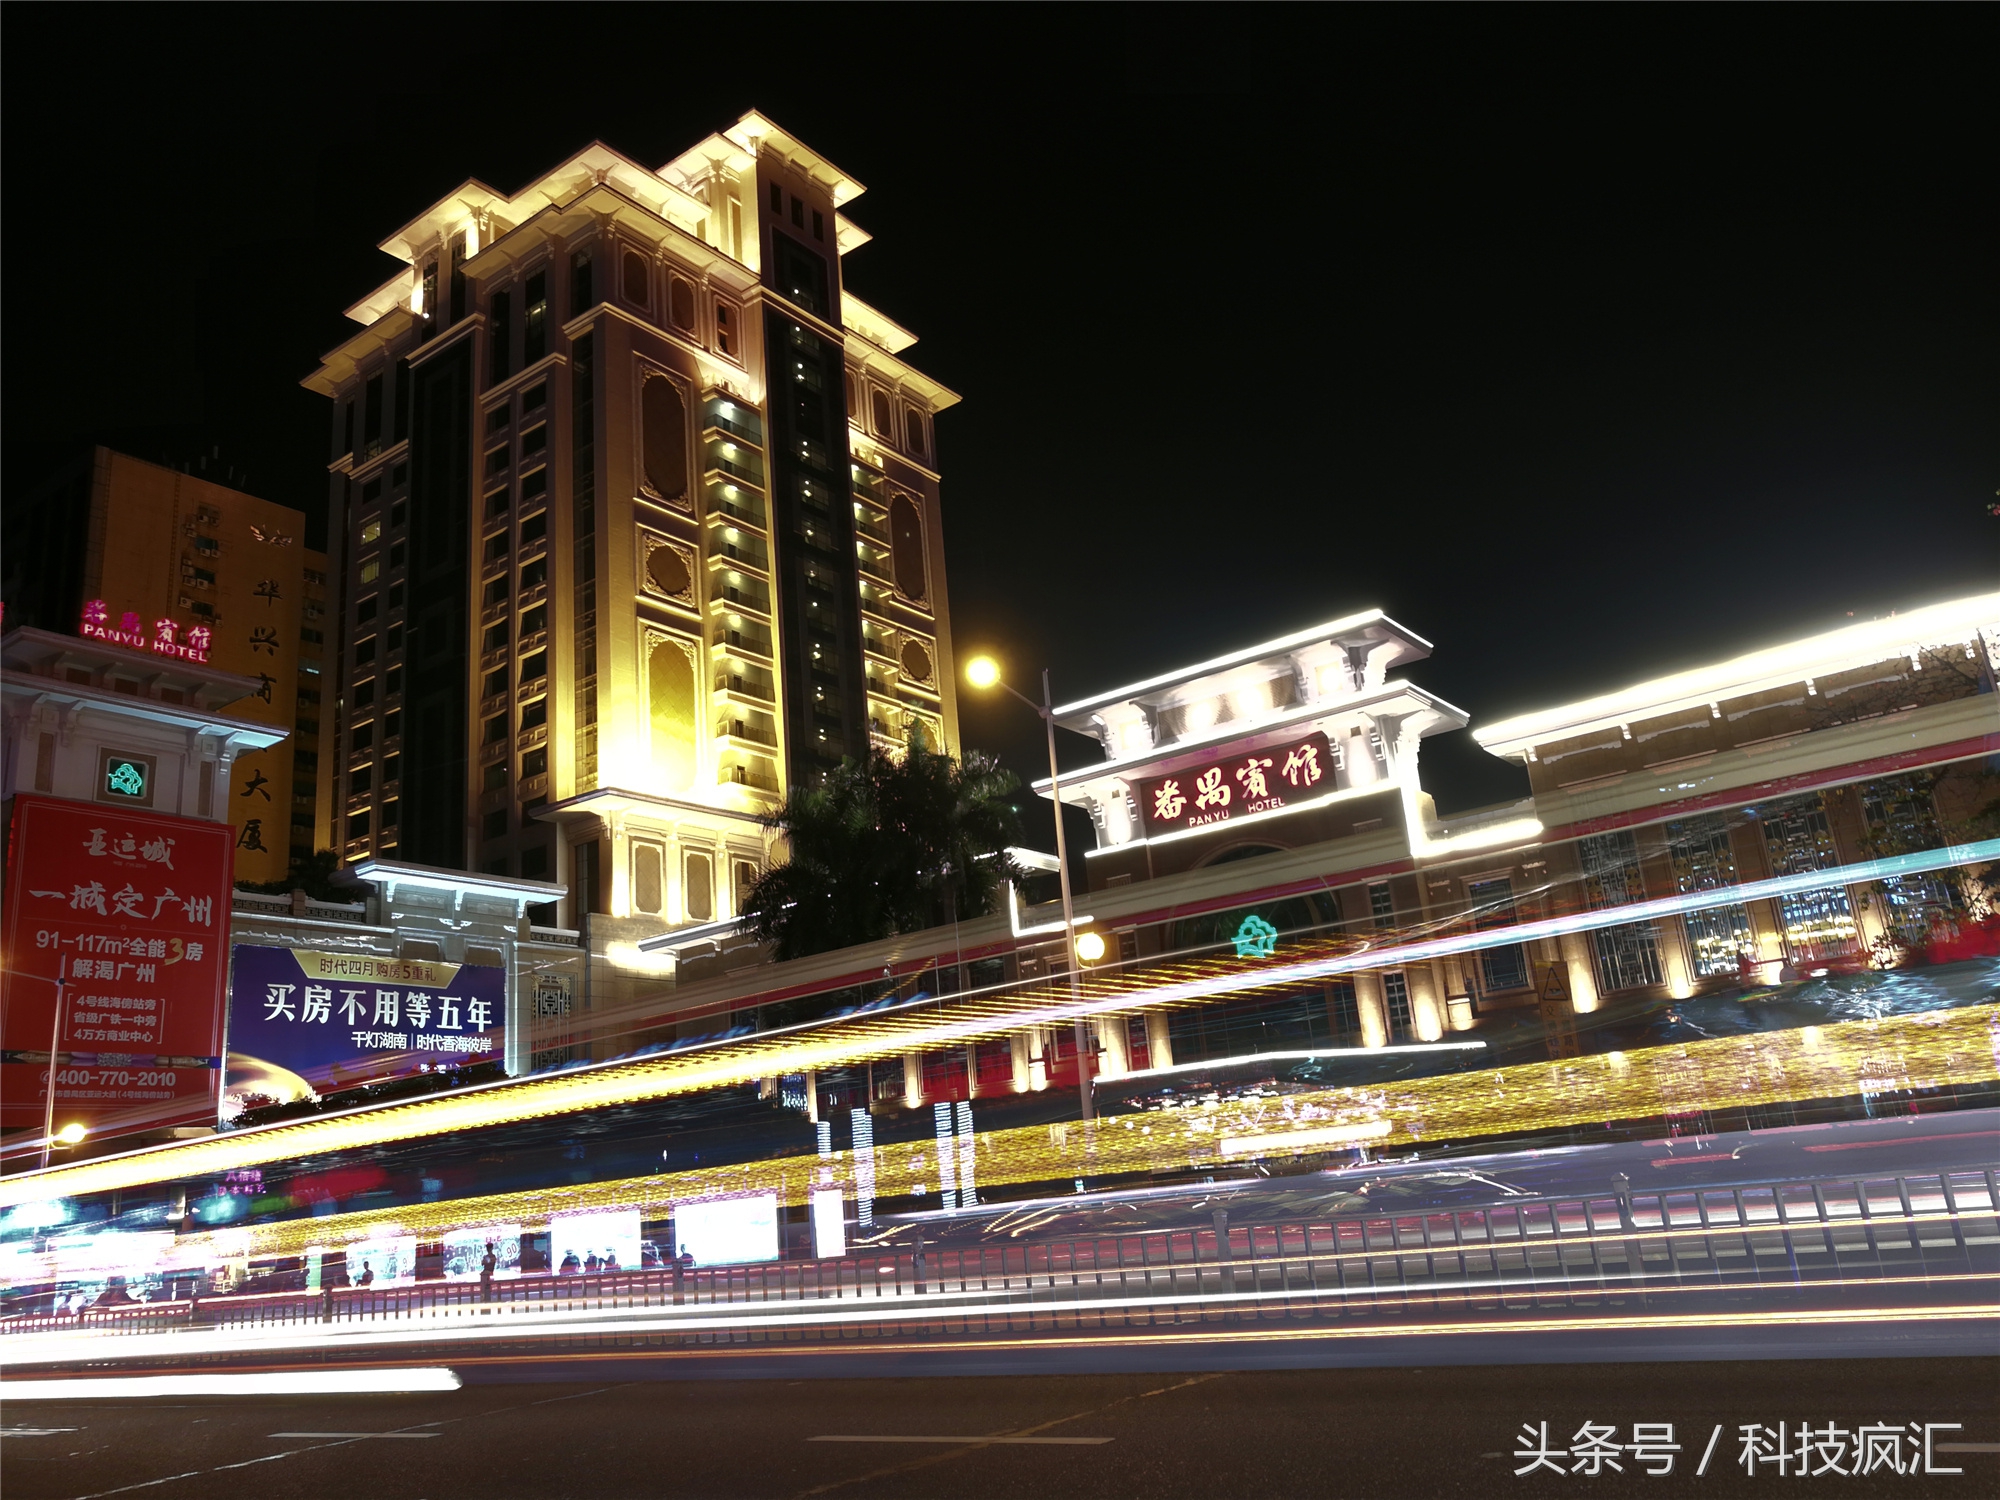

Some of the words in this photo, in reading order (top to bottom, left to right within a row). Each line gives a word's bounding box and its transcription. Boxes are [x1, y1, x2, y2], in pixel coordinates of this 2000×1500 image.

[84, 624, 145, 647] PANYU
[154, 640, 208, 662] HOTEL
[1189, 809, 1229, 828] PANYU
[1247, 797, 1285, 814] HOTEL
[28, 880, 213, 927] 一城定广州
[71, 958, 156, 983] 解渴广州
[320, 958, 437, 981] 时代四月购房5重礼
[74, 1011, 157, 1027] 省级广铁一中旁
[263, 983, 493, 1033] 买房不用等五年
[74, 1028, 154, 1043] 4万方商业中心
[351, 1031, 408, 1049] 千灯湖南
[416, 1034, 493, 1053] 时代香海彼岸
[56, 1069, 177, 1087] 400-770-2010
